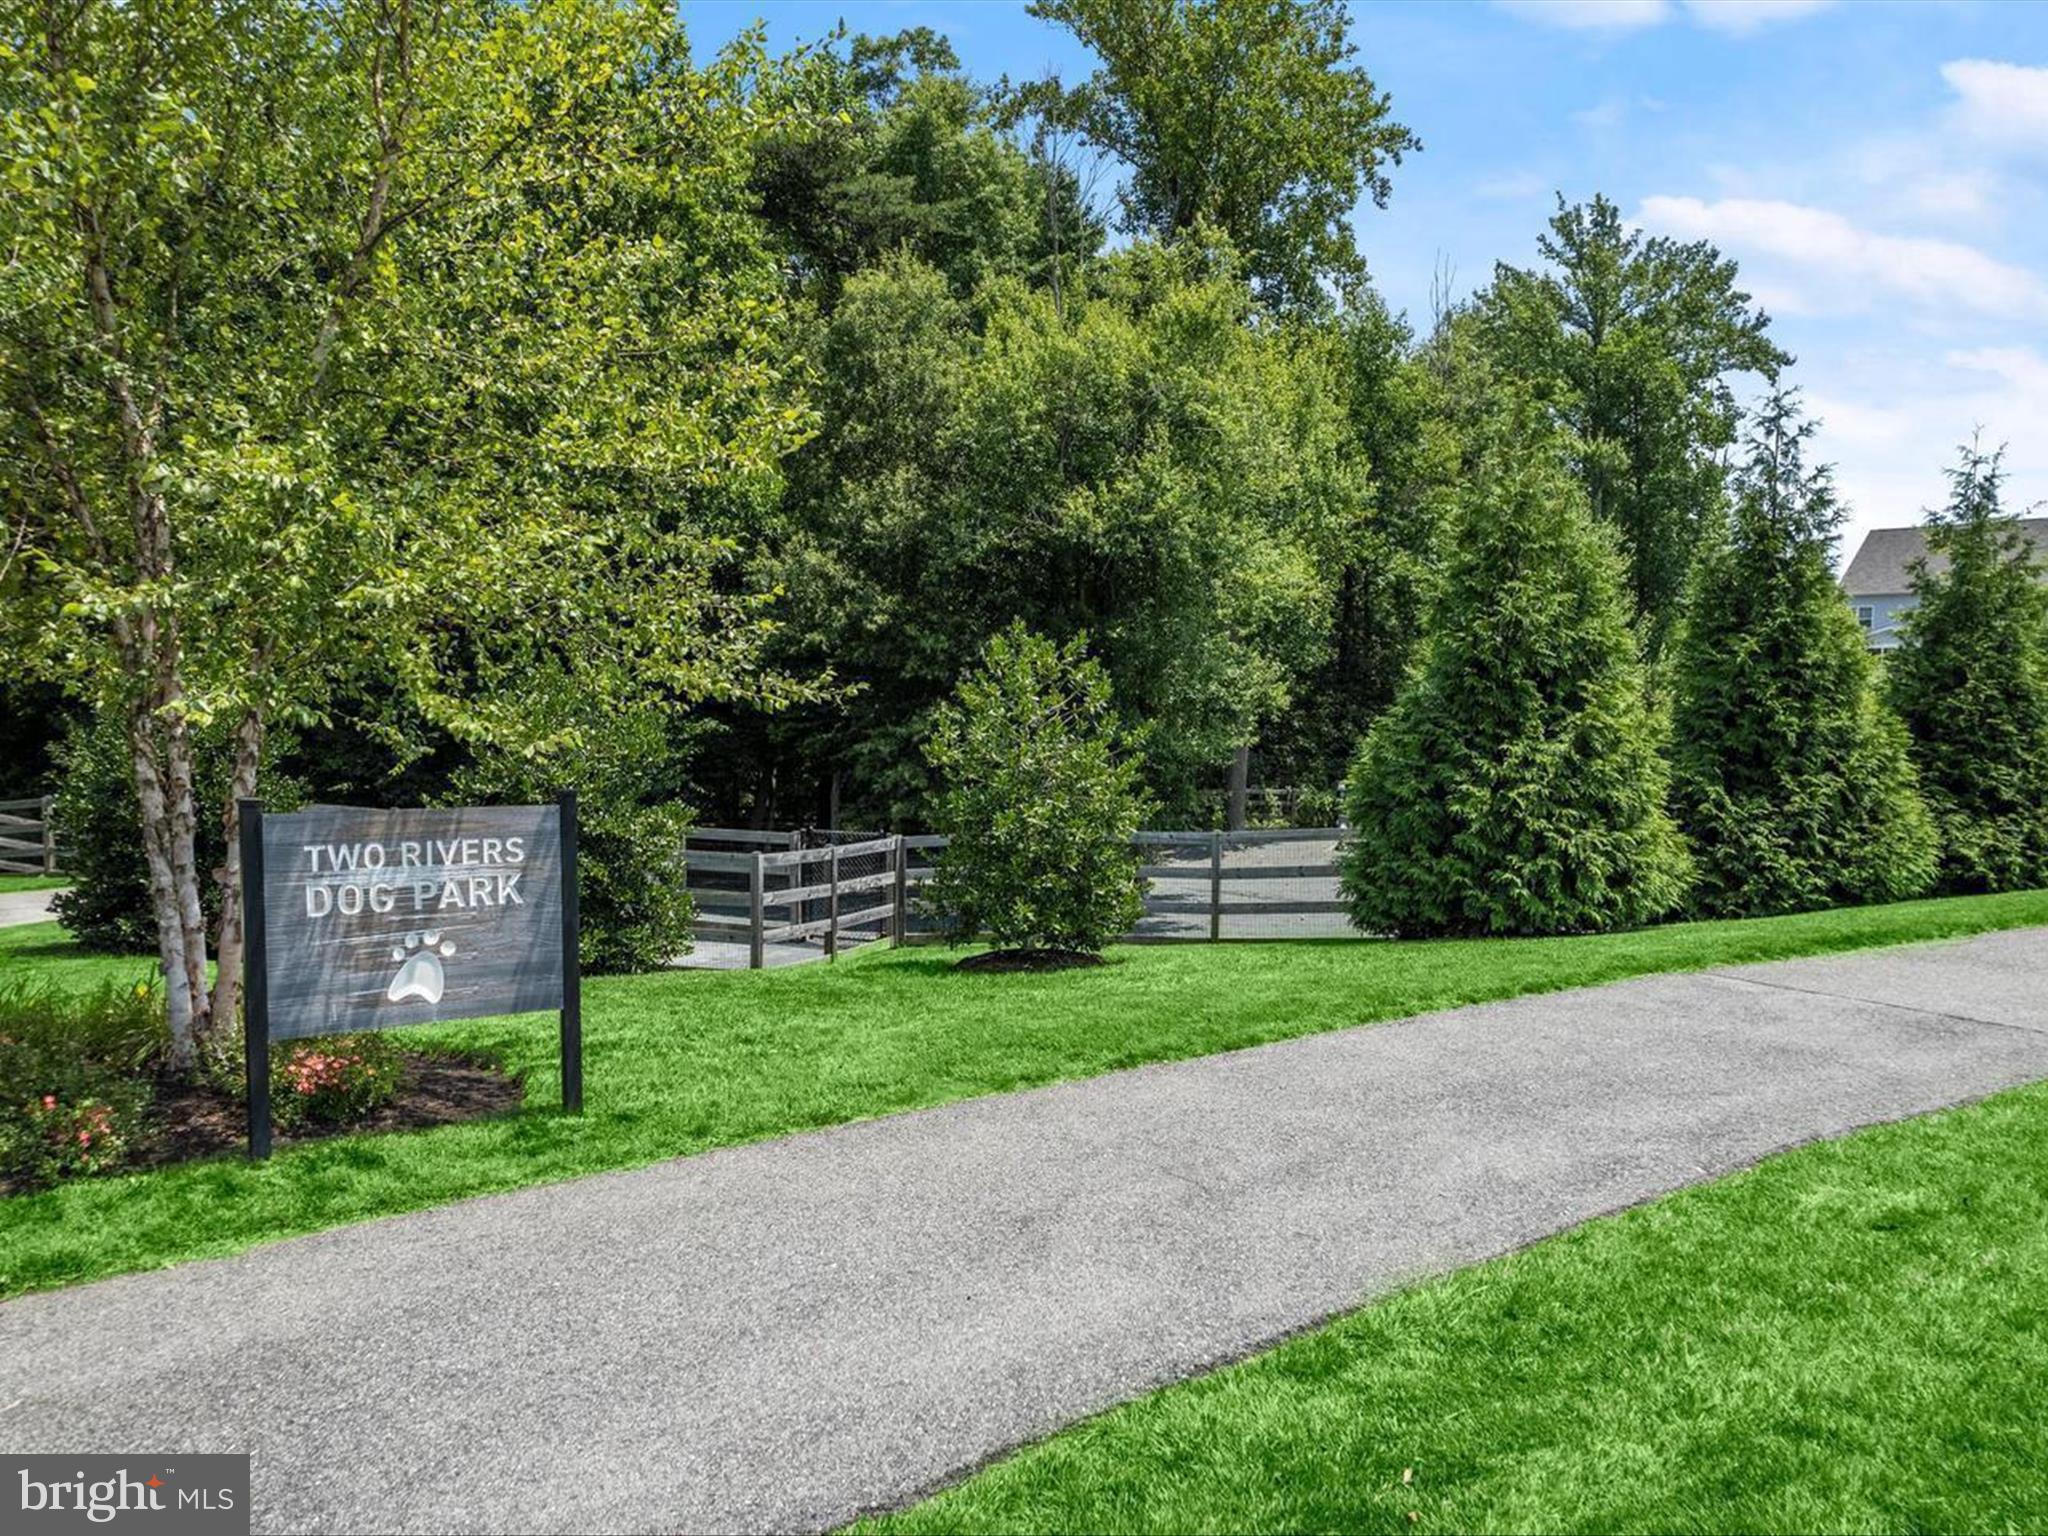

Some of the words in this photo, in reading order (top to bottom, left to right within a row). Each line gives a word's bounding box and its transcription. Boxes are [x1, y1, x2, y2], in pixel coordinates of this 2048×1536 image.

[304, 843, 386, 872] TWO
[402, 837, 525, 867] RIVERS
[305, 882, 395, 917] DOG
[413, 873, 524, 909] PARK
